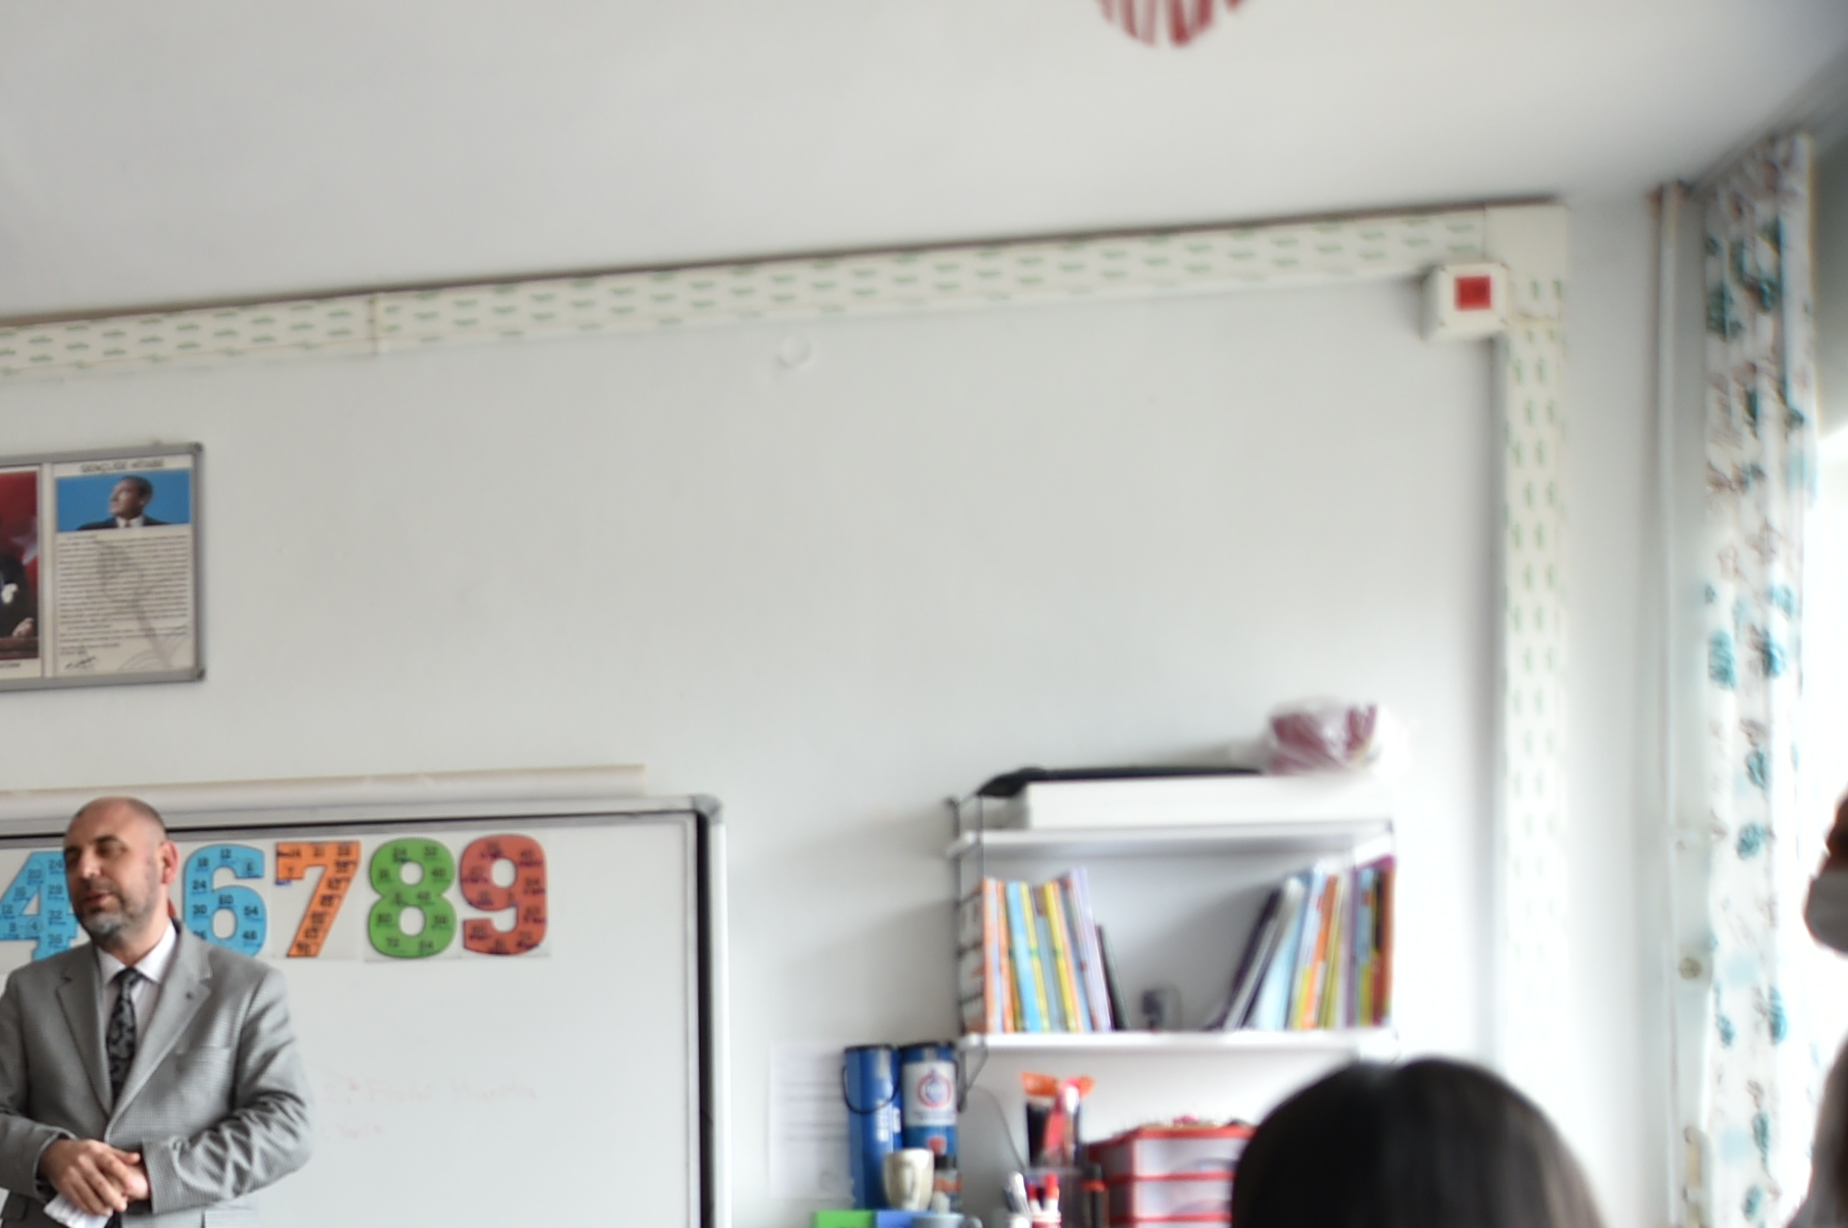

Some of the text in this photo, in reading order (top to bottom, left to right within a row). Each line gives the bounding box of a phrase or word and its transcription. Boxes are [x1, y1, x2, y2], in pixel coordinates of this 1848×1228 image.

[183, 844, 267, 957] 6
[275, 840, 360, 958] 7
[368, 836, 457, 959] 8
[459, 833, 547, 957] 9
